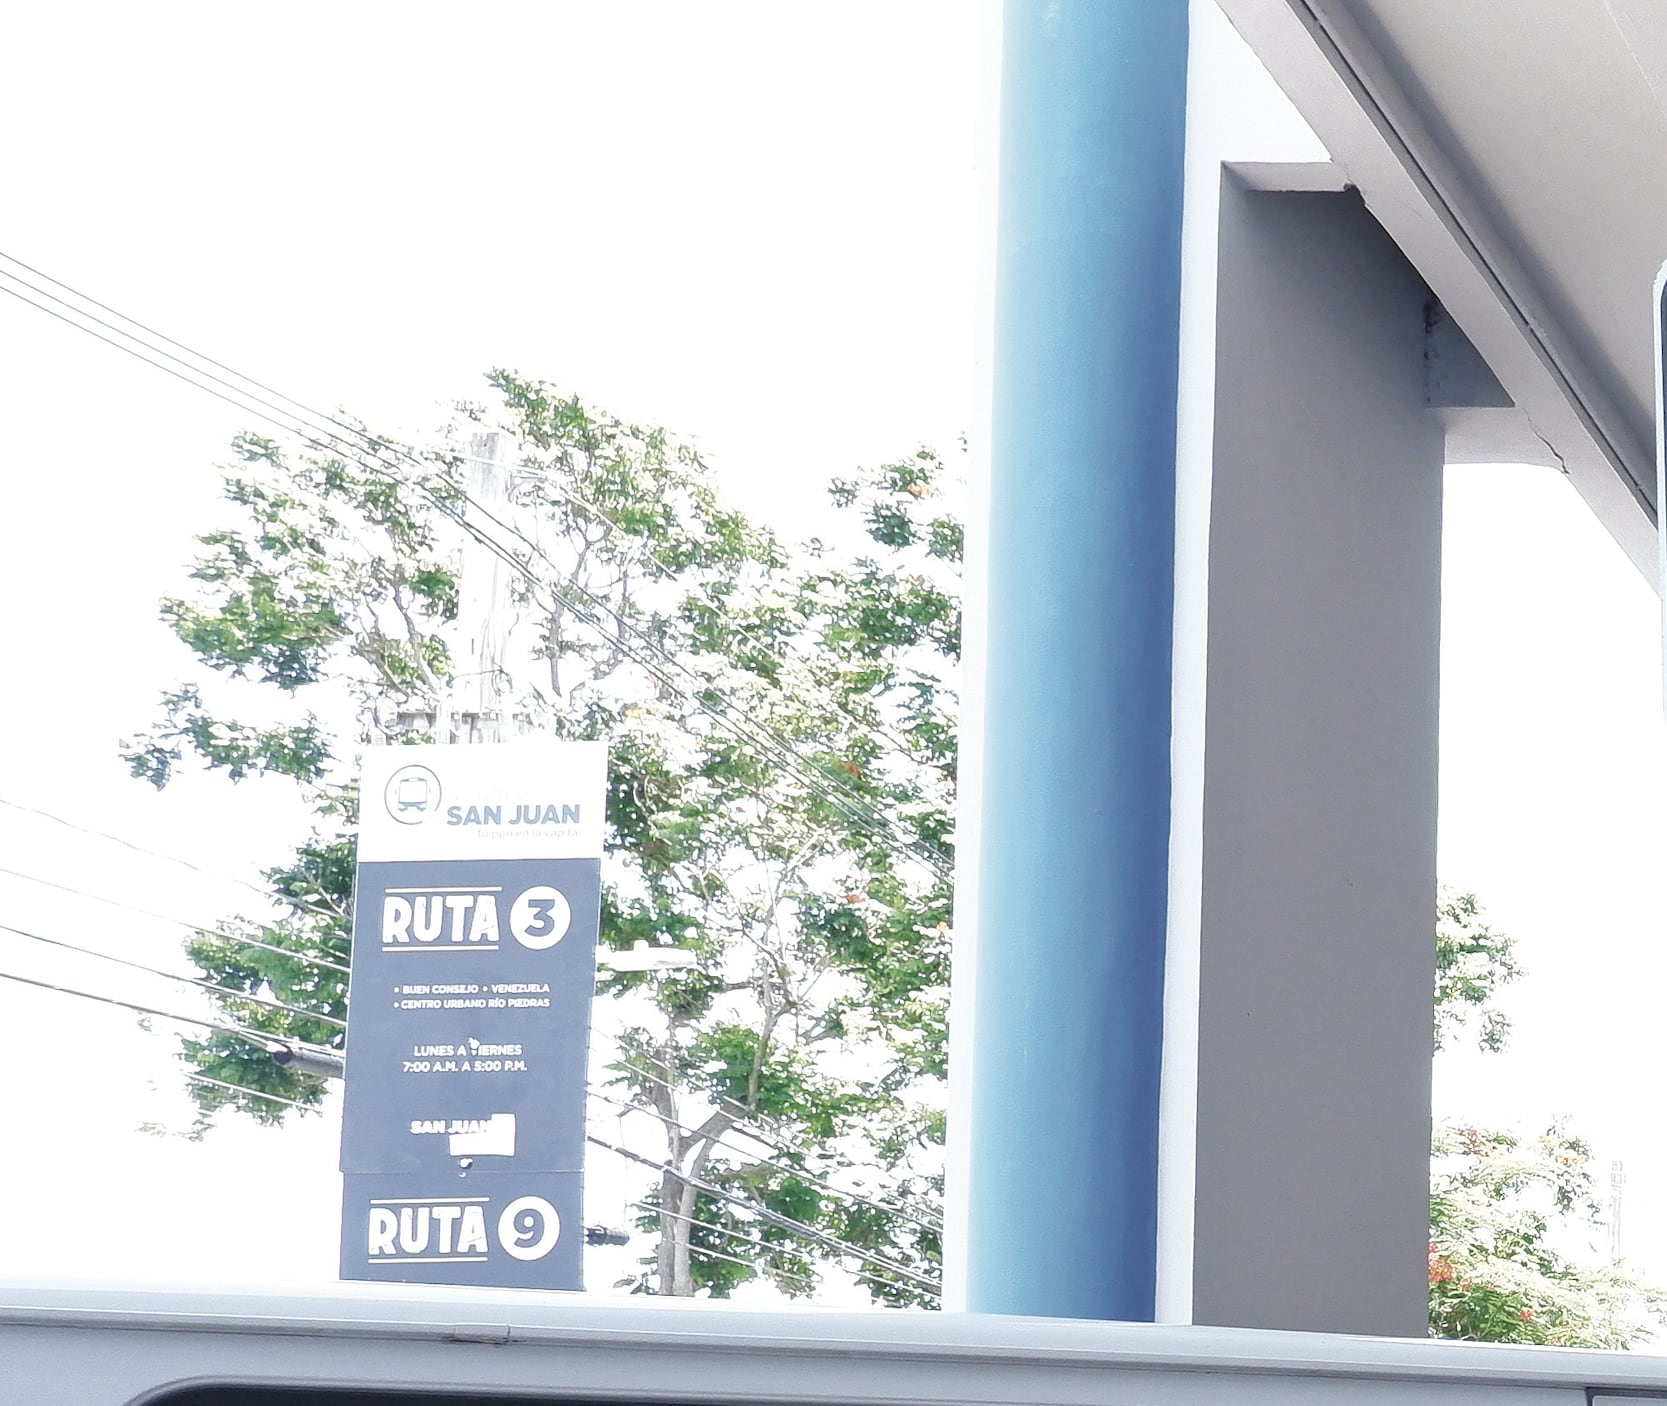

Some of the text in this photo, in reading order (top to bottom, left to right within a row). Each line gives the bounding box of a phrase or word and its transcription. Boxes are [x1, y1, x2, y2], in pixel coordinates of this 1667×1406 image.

[446, 803, 581, 827] SAN JUAN
[382, 894, 556, 943] RUTA 3
[402, 983, 550, 995] BUEN CONSEJO VENEZUELA
[401, 997, 550, 1010] CENTRO URBANO RÍO PIEDRAS
[413, 1045, 455, 1057] LUNES
[456, 1045, 467, 1057] A
[402, 1060, 528, 1073] 7:00 A.M. A 5:00 P.M.
[410, 1119, 492, 1135] SAN JUAN
[368, 1205, 546, 1255] RUTA 9
